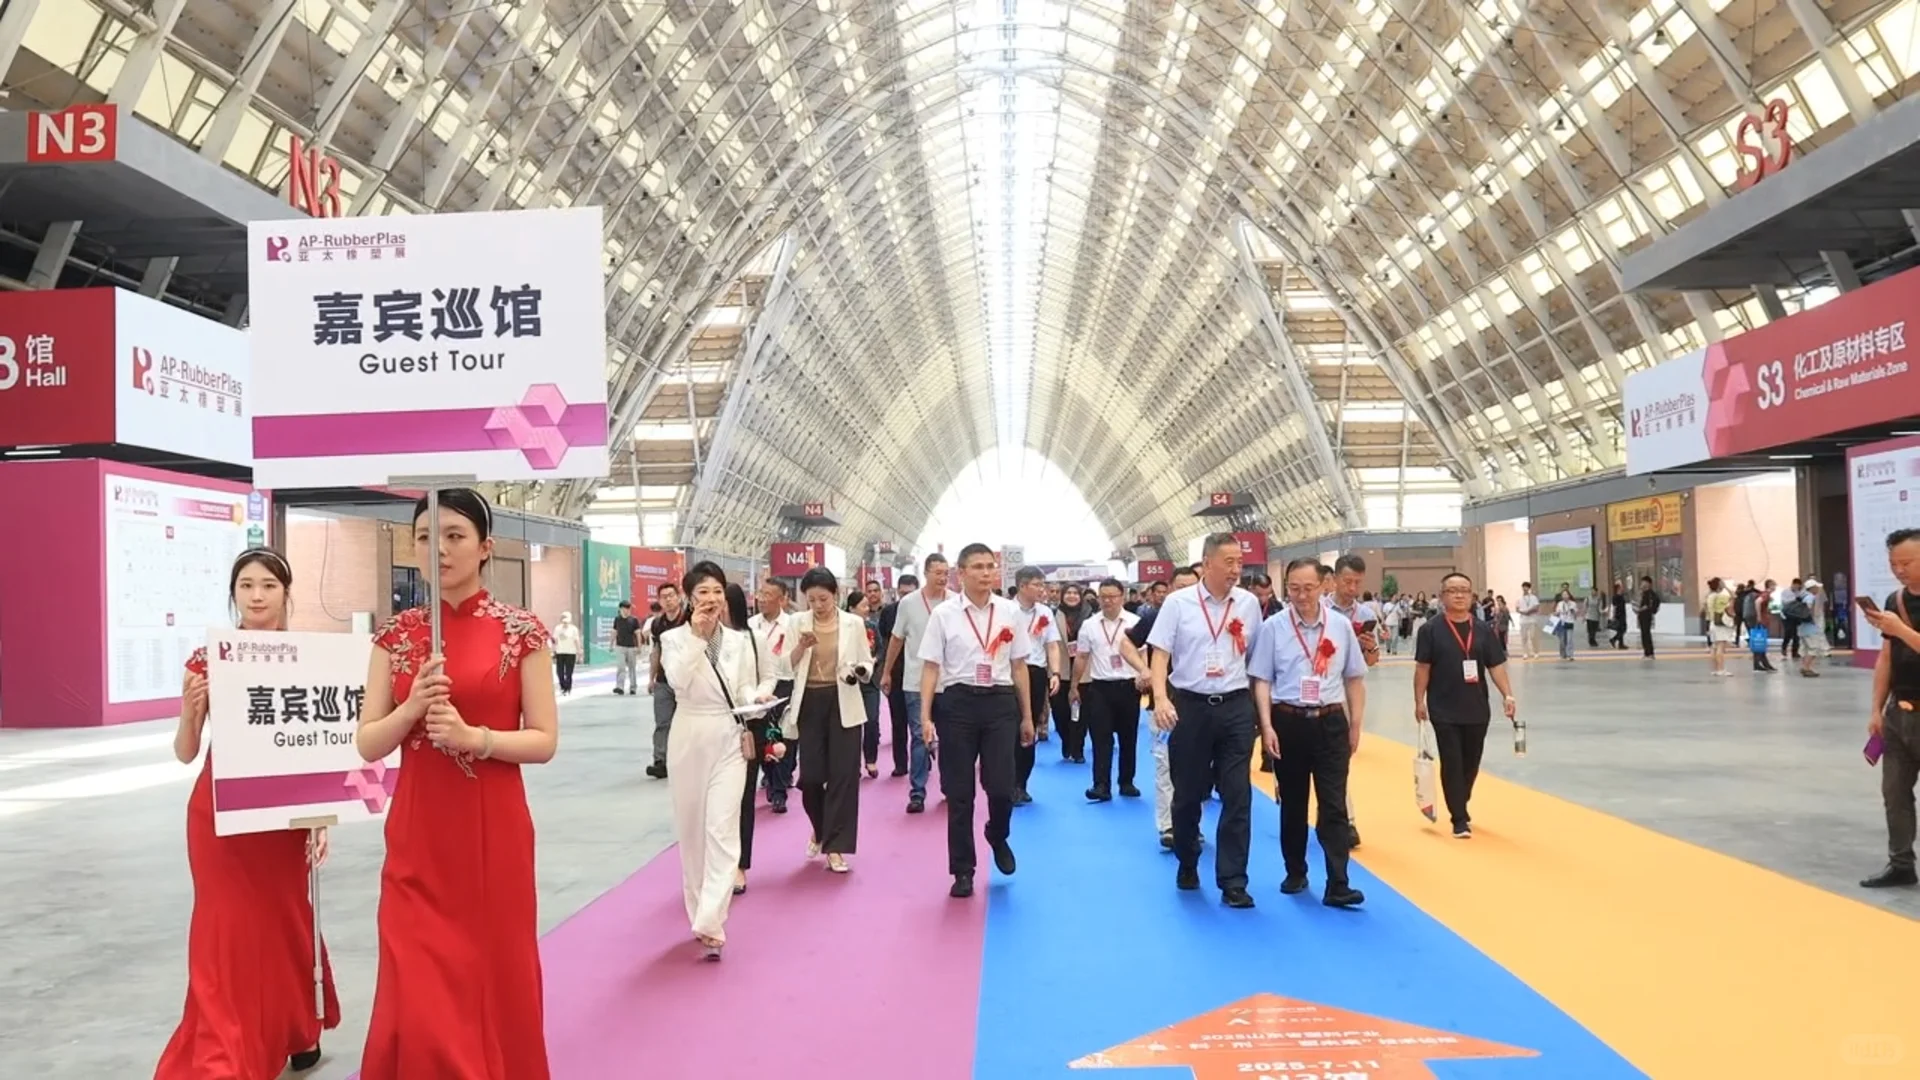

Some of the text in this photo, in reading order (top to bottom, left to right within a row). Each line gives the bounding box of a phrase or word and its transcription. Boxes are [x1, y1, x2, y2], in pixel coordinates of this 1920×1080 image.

[37, 112, 107, 154] N3
[1733, 98, 1791, 193] S3
[289, 135, 341, 217] N3
[299, 232, 406, 248] AP-RubberPlas
[298, 247, 406, 262] 亚太橡塑展
[313, 284, 542, 345] 嘉宾巡馆
[25, 334, 55, 364] 馆
[359, 350, 505, 374] Guest Tour
[1794, 321, 1906, 380] 化工及原材料专区
[26, 366, 67, 387] Hall
[160, 355, 242, 396] AP-RubberPlas
[1757, 360, 1785, 410] S3
[1794, 380, 1826, 400] Chemical
[1833, 376, 1850, 390] Raw
[1850, 366, 1885, 385] Materials
[1886, 361, 1908, 377] Zone
[805, 505, 822, 515] N4
[1213, 494, 1228, 505] S4
[786, 552, 804, 564] N4
[274, 730, 353, 747] Guest Tour
[1237, 1060, 1380, 1072] 2025-7-11
